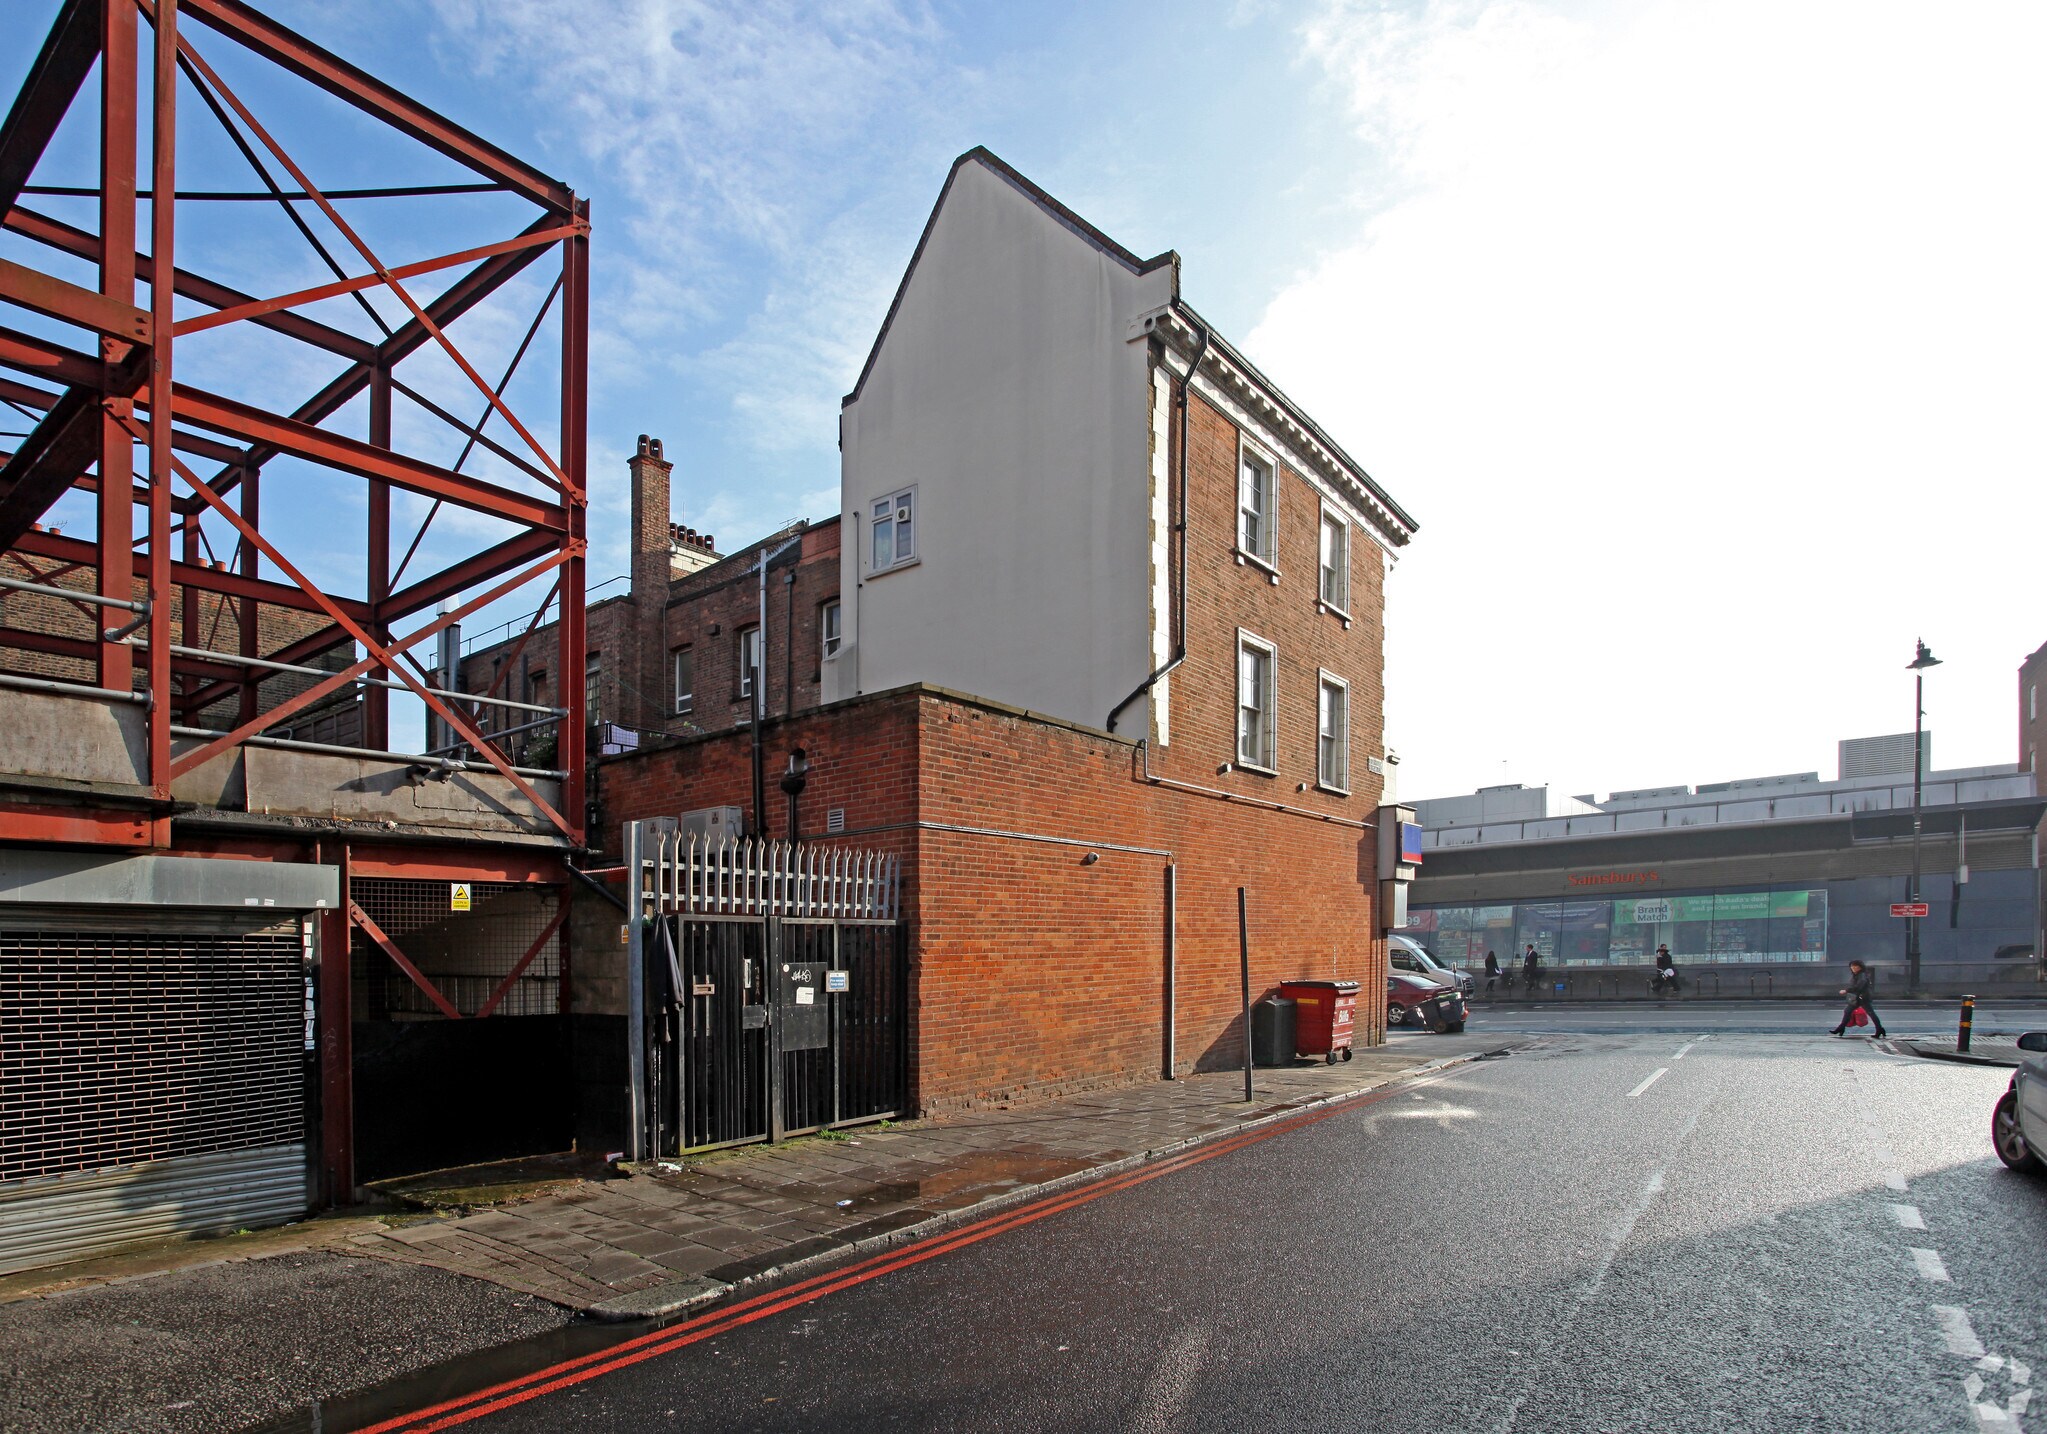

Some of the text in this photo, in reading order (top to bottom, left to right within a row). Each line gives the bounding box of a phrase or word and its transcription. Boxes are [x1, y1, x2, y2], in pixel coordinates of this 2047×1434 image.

[1567, 870, 1658, 887] Sainsbury's
[1637, 904, 1668, 914] Brand
[1637, 914, 1668, 922] Match
